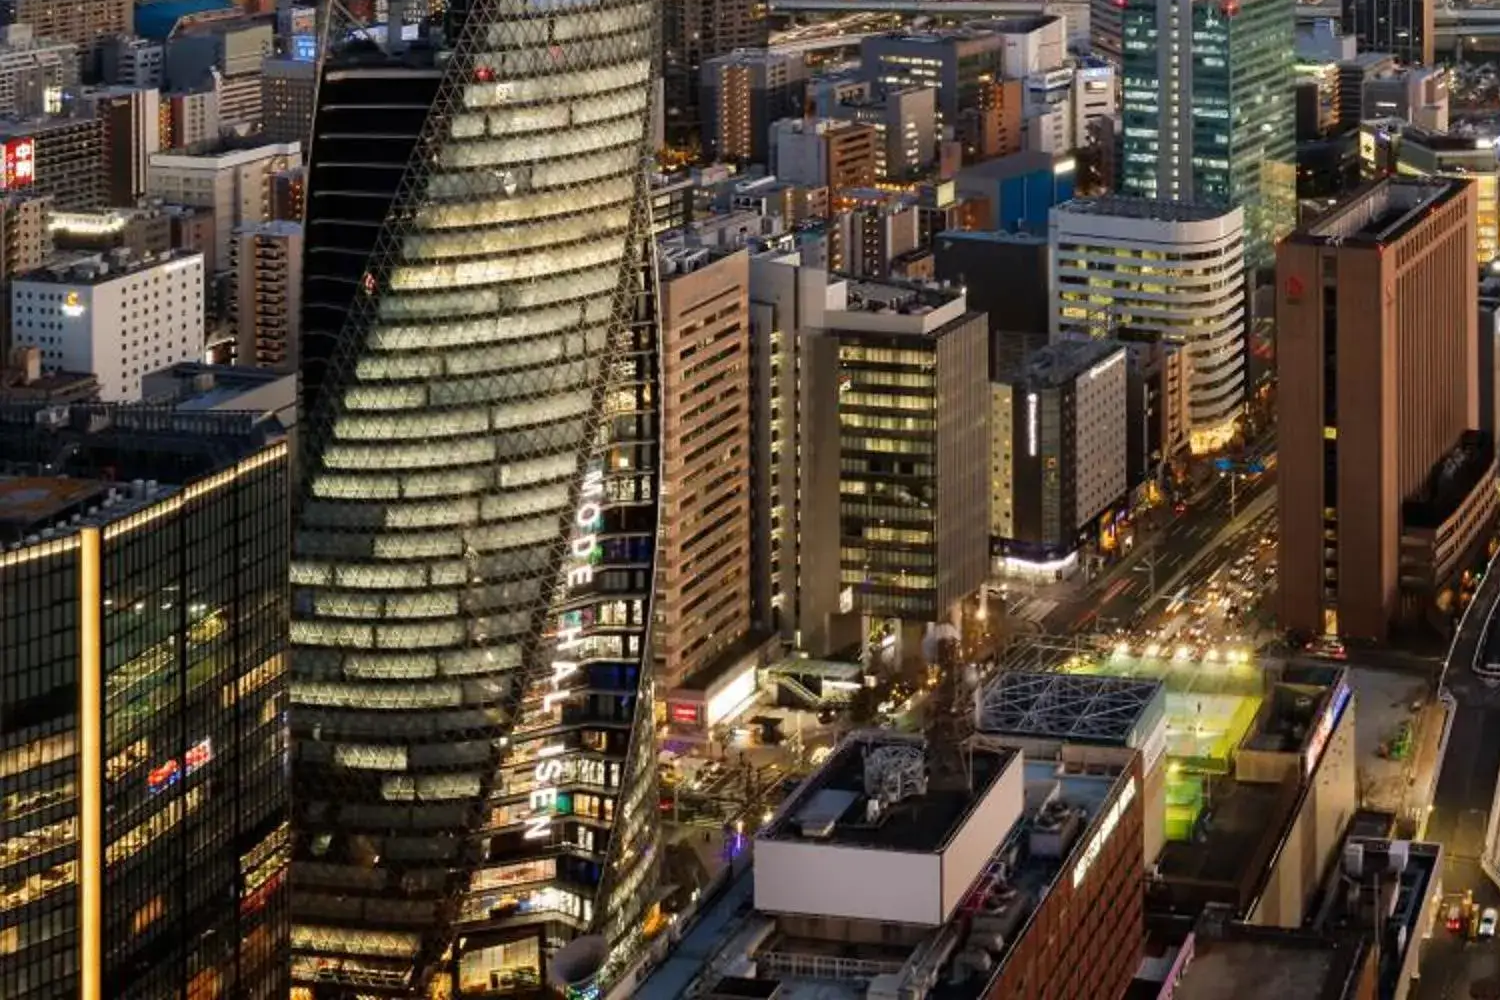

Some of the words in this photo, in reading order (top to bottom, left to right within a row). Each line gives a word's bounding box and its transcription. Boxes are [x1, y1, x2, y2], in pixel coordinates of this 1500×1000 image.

[567, 470, 603, 587] MODE
[543, 625, 582, 713] HAL
[524, 744, 565, 840] ISEN
